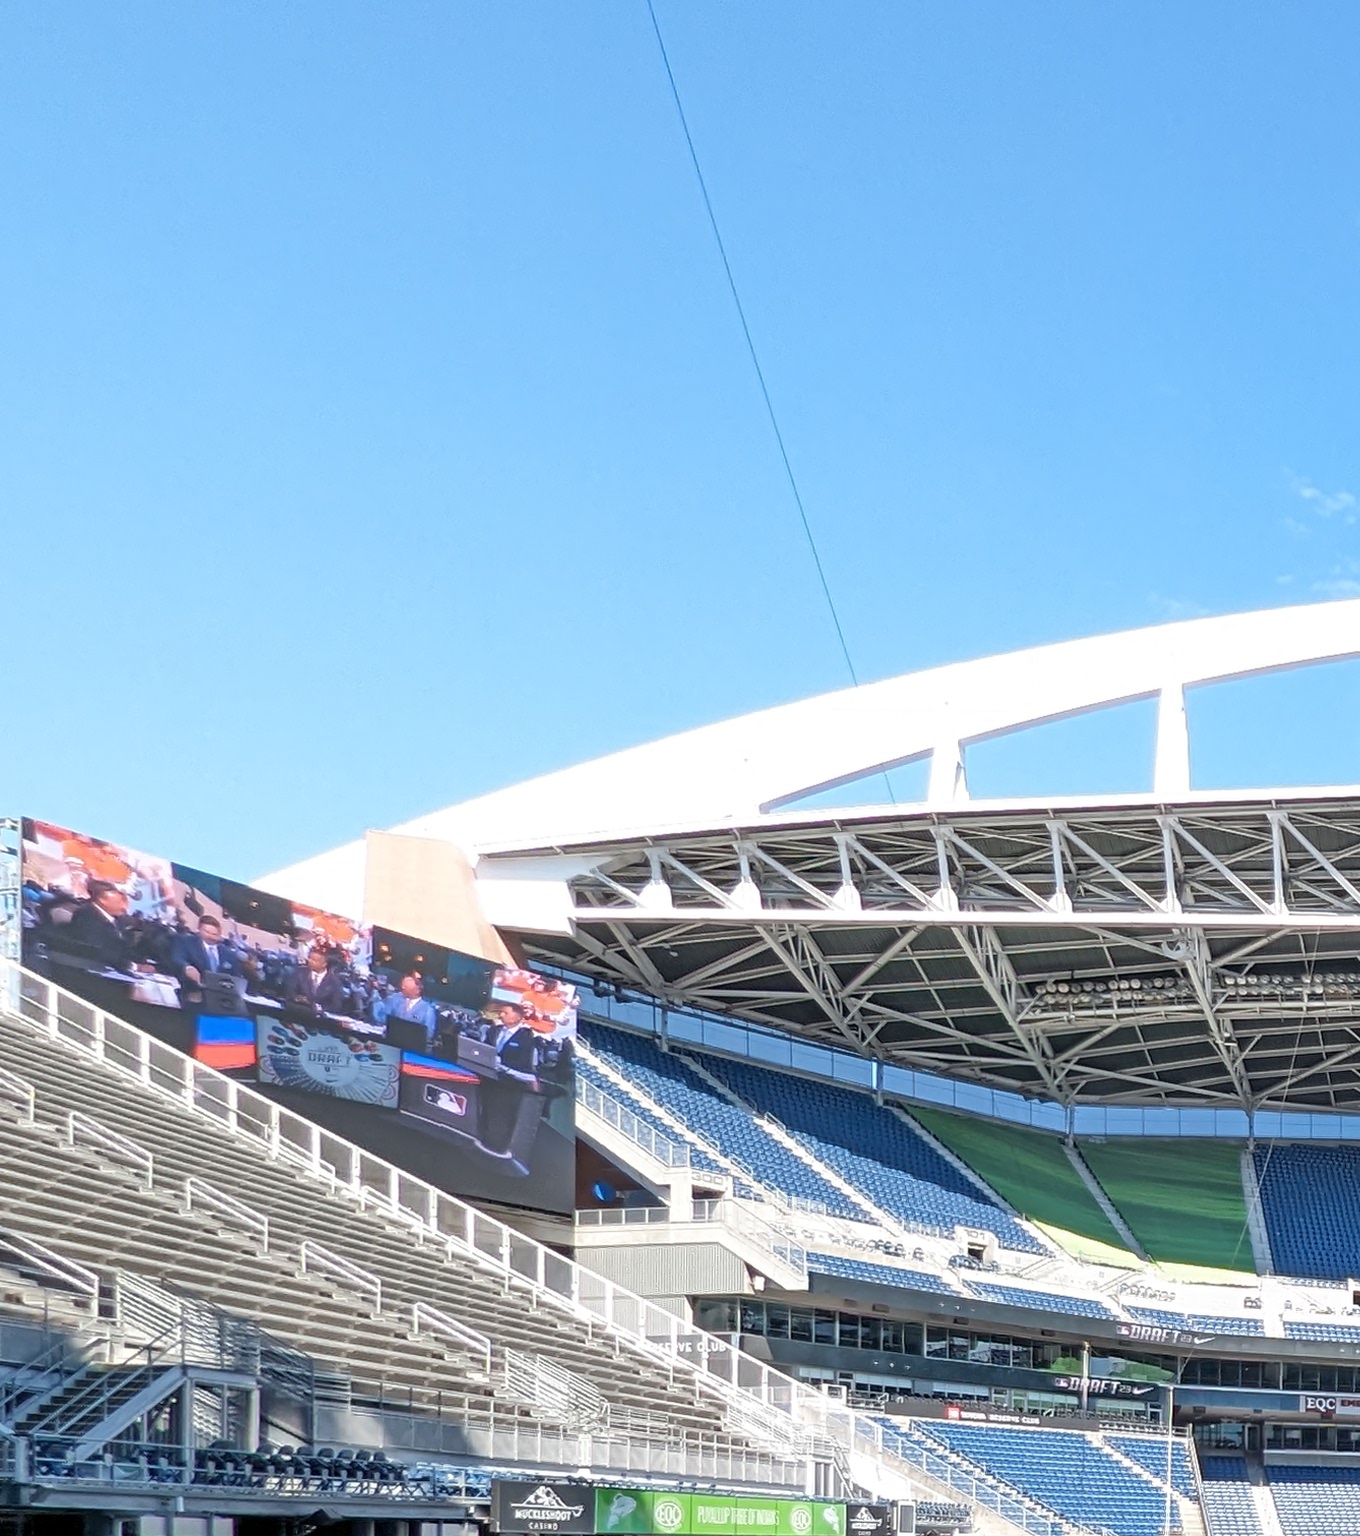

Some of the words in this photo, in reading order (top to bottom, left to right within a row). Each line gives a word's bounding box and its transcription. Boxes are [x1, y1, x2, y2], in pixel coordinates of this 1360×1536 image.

[1130, 1326, 1181, 1344] DRAFT
[1070, 1377, 1120, 1394] DRAFT
[1306, 1397, 1336, 1412] EQC
